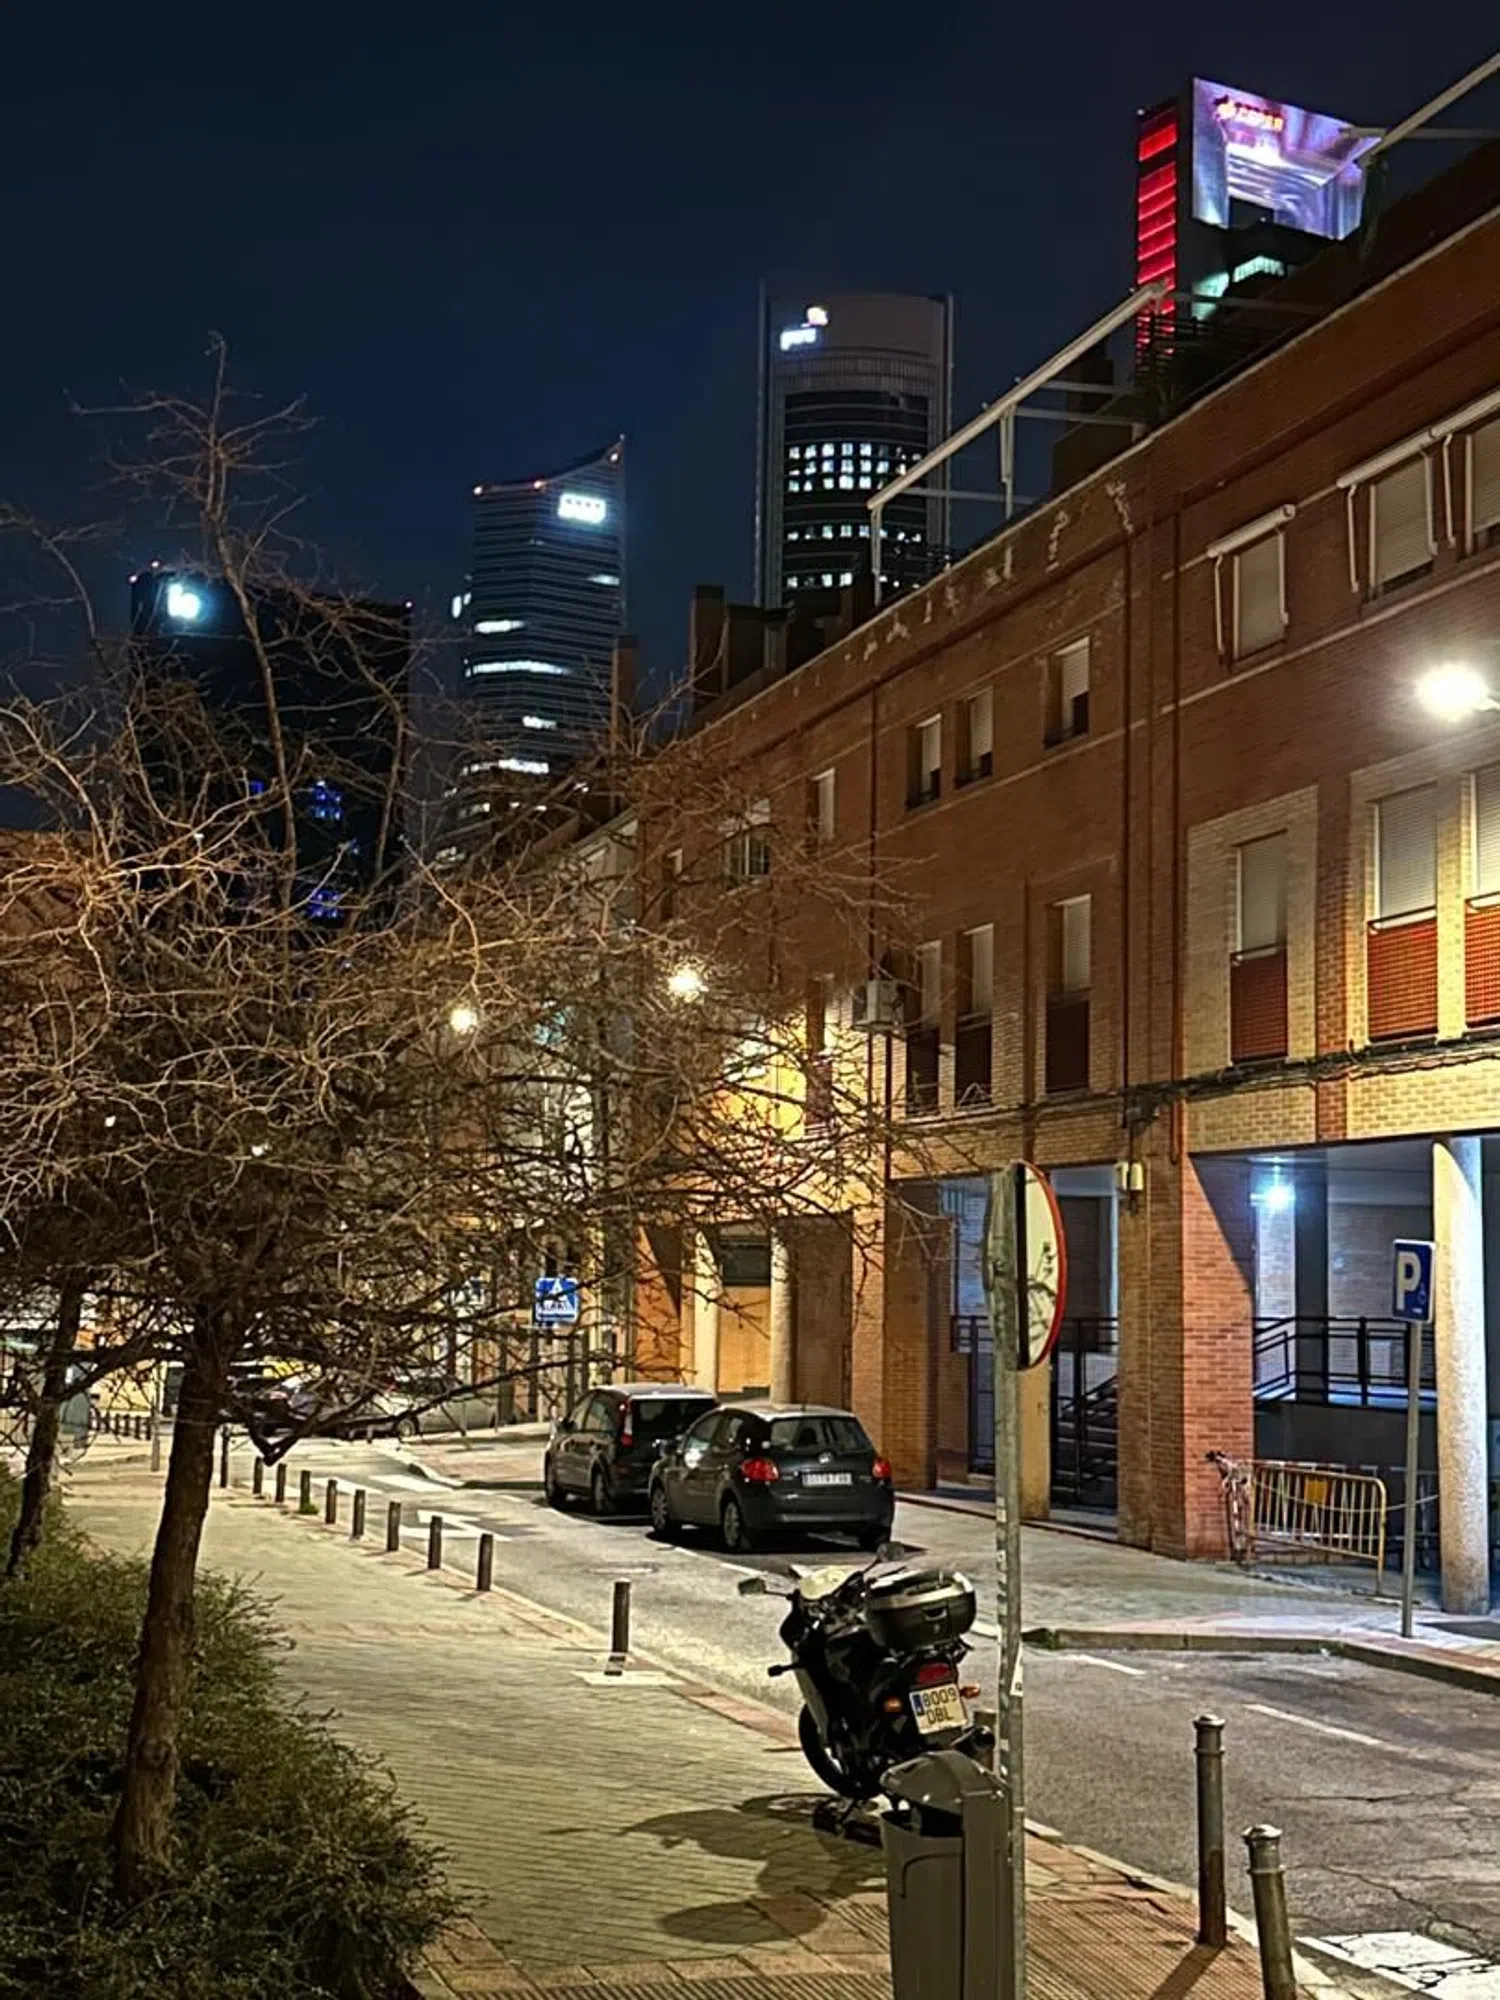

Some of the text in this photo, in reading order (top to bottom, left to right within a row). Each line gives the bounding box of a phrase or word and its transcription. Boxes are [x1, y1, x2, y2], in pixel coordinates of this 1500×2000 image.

[1397, 1251, 1421, 1310] P
[922, 1687, 957, 1707] 8009
[926, 1706, 955, 1725] DBL
